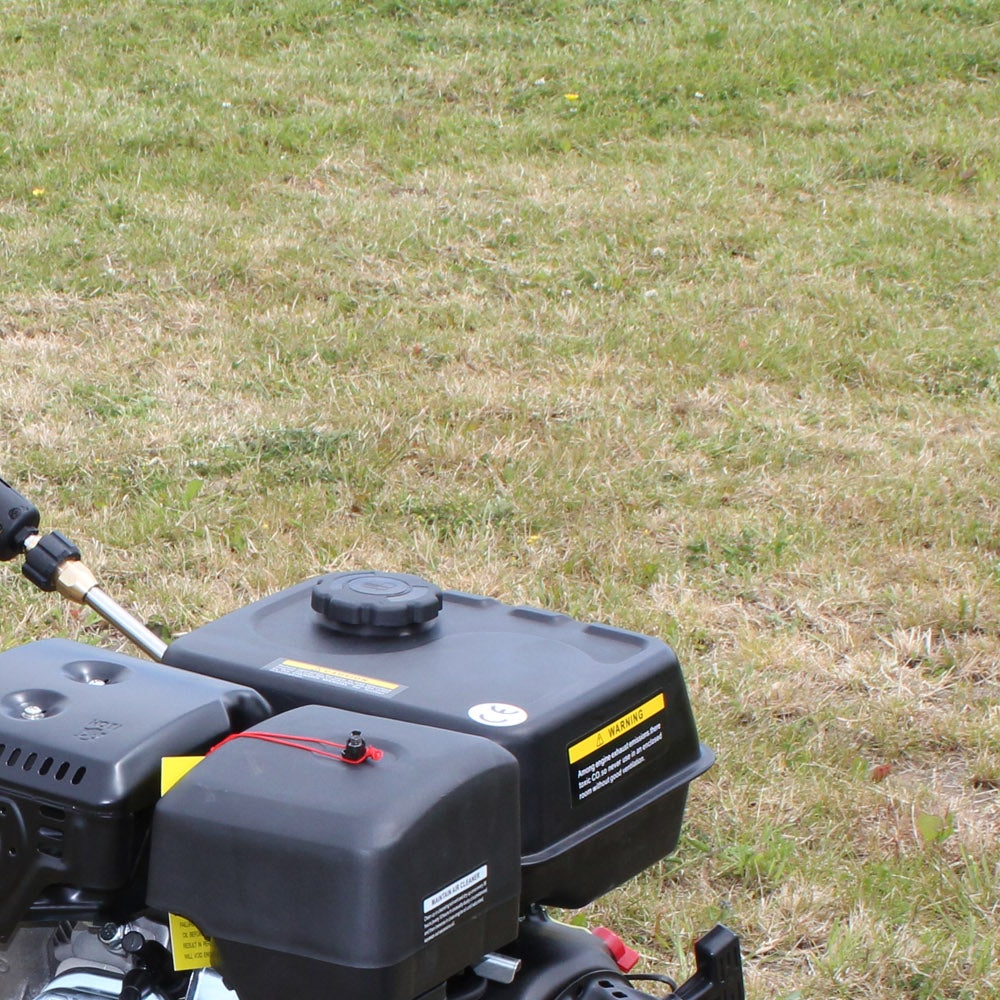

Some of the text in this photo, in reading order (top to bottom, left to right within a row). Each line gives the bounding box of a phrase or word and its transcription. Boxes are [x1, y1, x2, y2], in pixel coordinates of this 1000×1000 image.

[608, 709, 644, 738] WARNING
[578, 764, 595, 778] Among
[595, 755, 611, 768] engine
[611, 742, 629, 758] exhaust
[650, 723, 661, 734] there
[579, 777, 591, 789] toxic
[608, 759, 621, 771] never
[622, 754, 631, 763] use
[636, 746, 642, 754] an
[642, 732, 662, 750] enclosed
[579, 788, 592, 800] room
[592, 776, 610, 792] without
[609, 769, 622, 783] good
[460, 872, 480, 888] CLEANER
